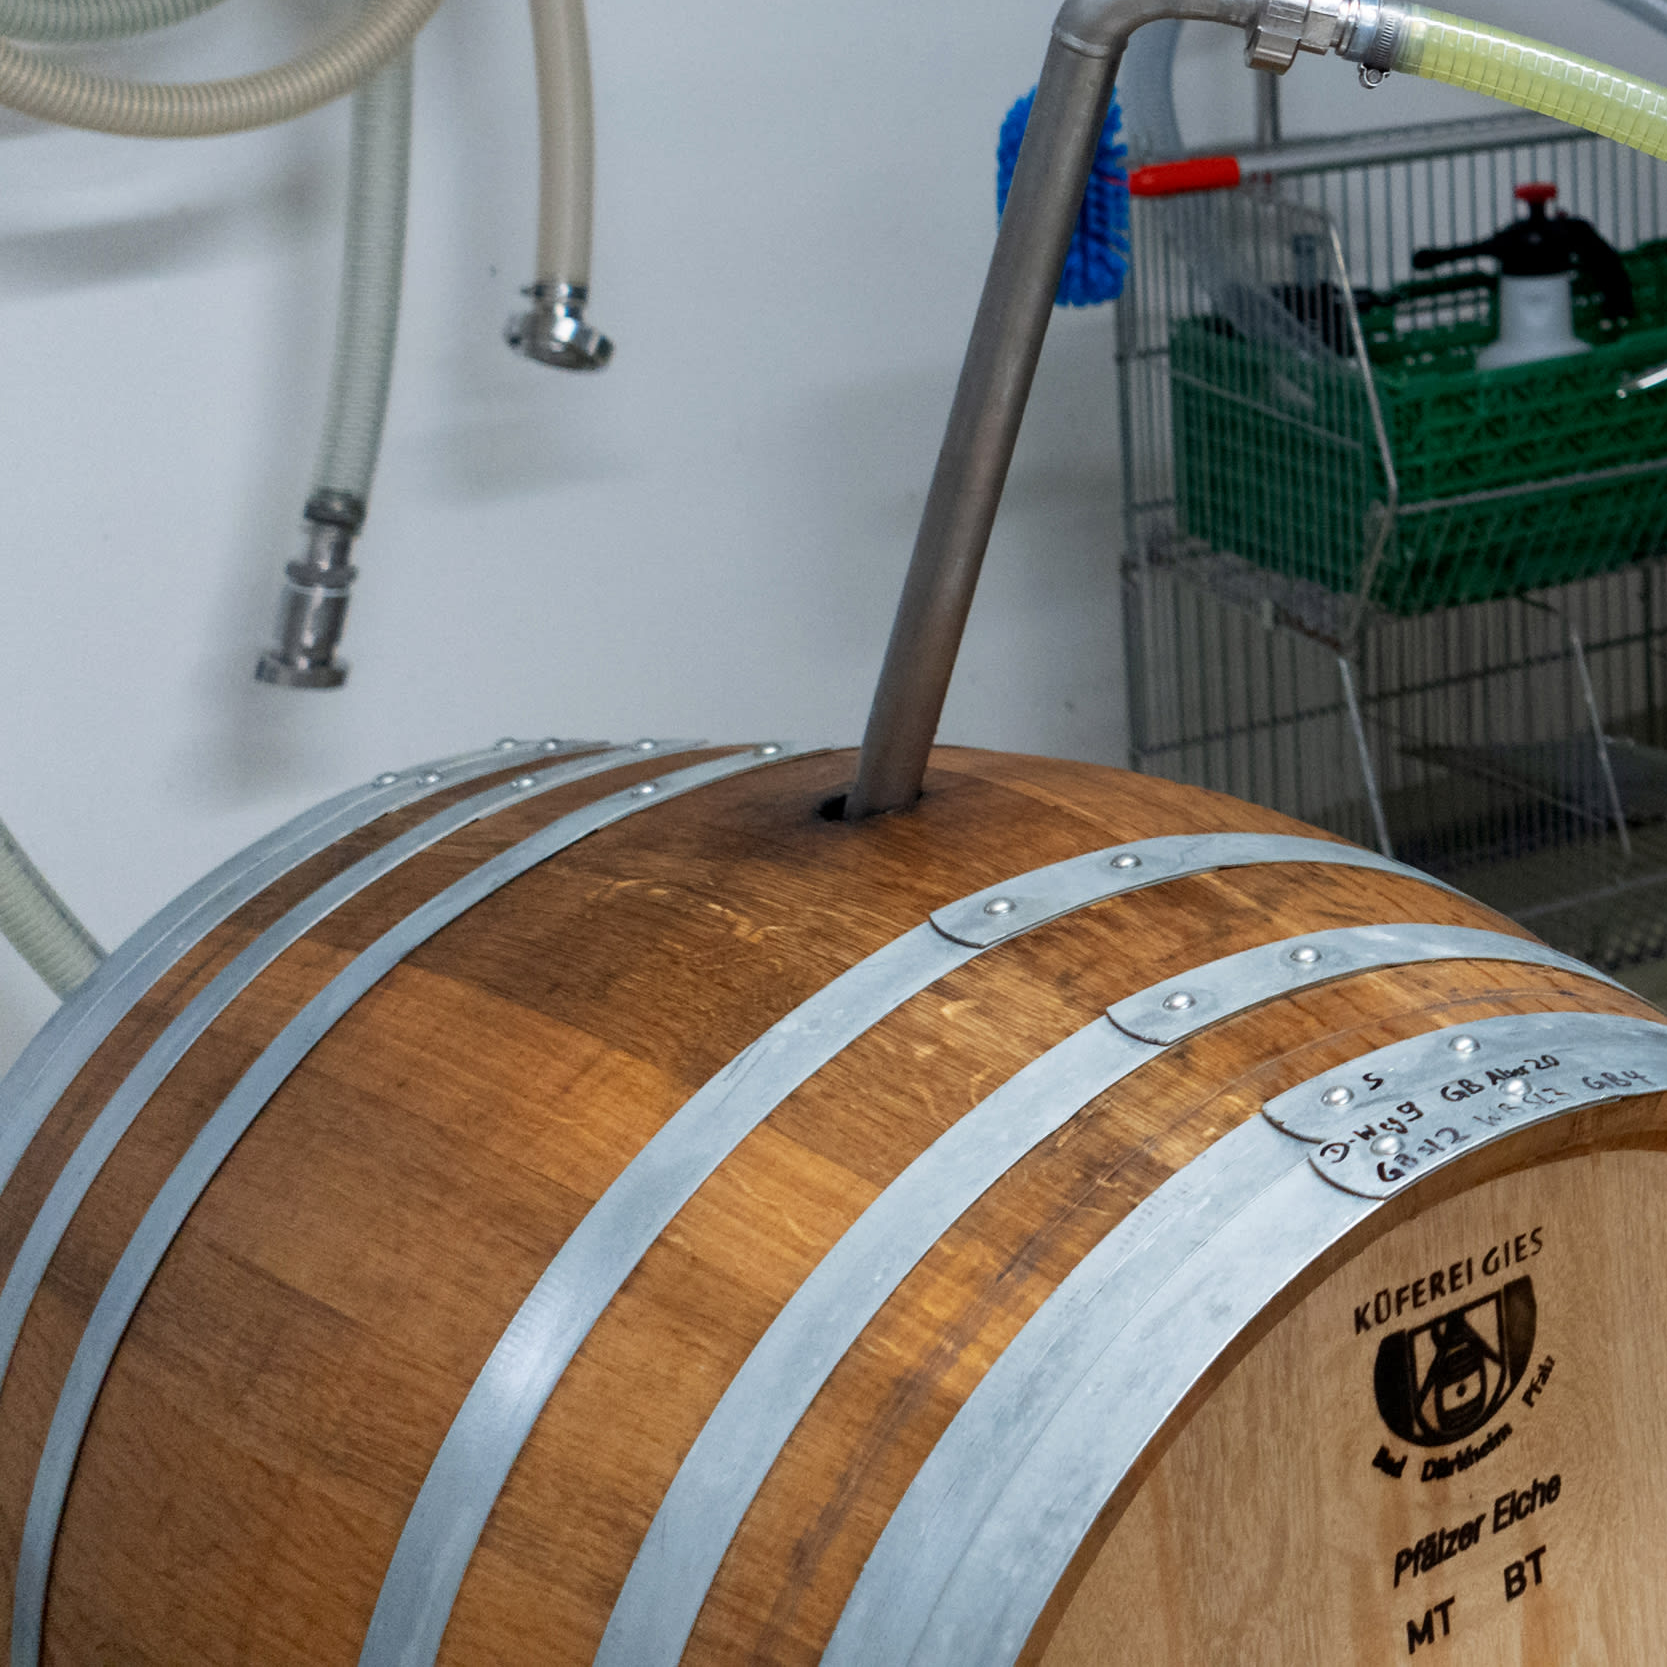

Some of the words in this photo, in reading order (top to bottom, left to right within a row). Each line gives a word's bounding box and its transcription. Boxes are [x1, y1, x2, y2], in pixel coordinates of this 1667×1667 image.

[1440, 1079, 1485, 1102] GB
[1482, 1226, 1543, 1276] GIES
[1393, 1512, 1487, 1589] Pfälzer
[1406, 1595, 1455, 1655] MT
[1503, 1544, 1547, 1602] BT
